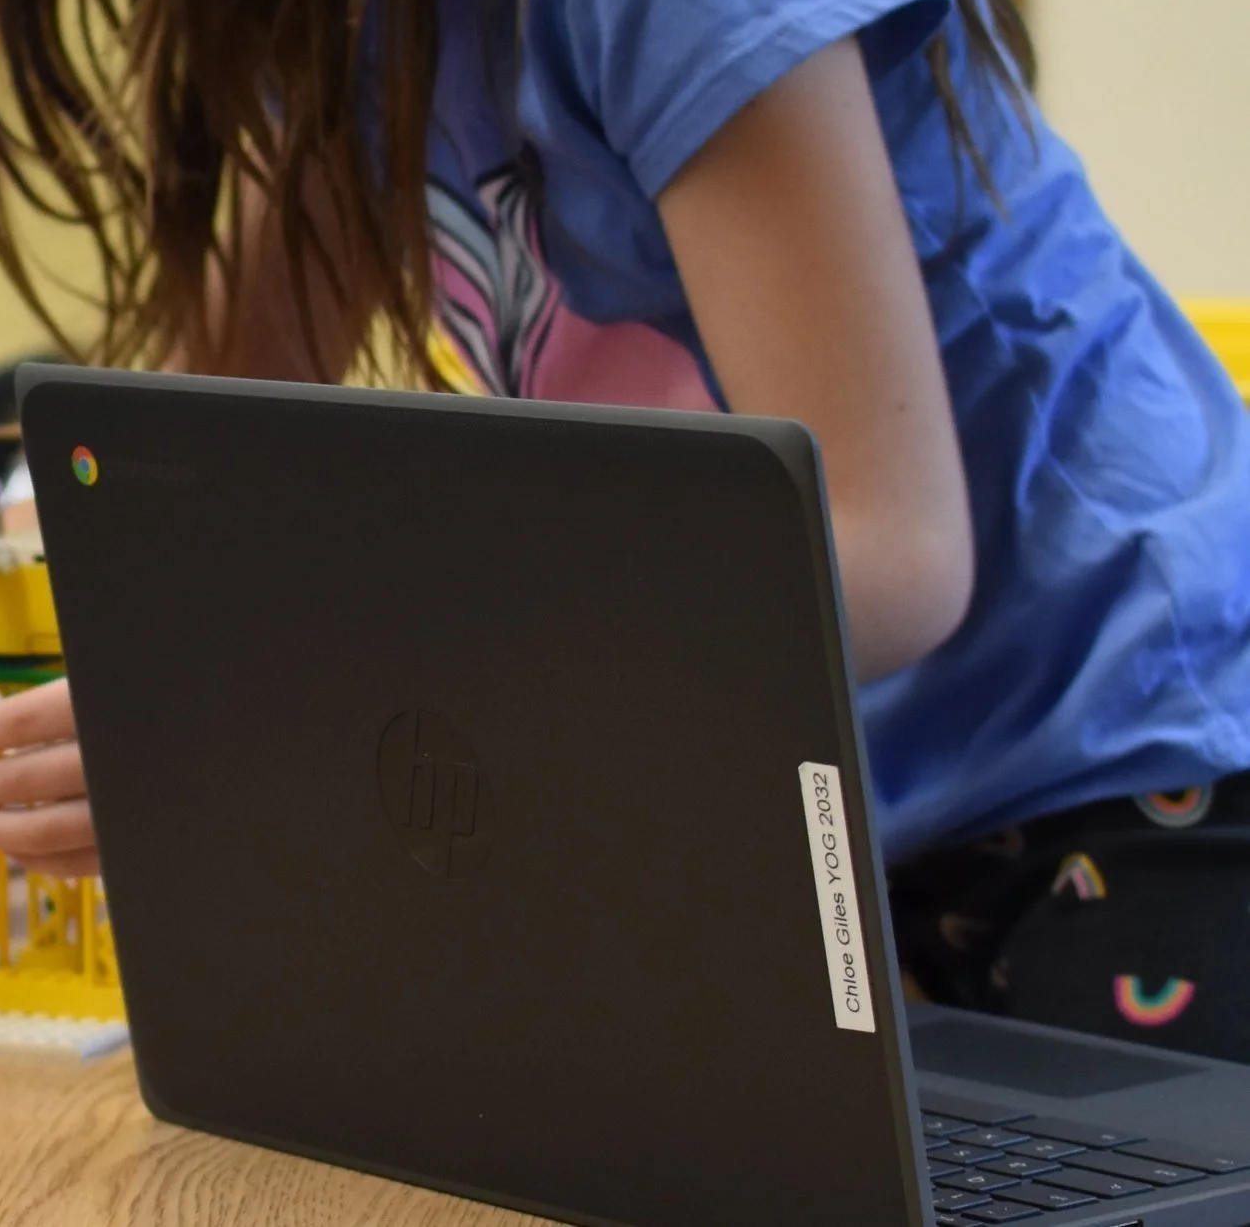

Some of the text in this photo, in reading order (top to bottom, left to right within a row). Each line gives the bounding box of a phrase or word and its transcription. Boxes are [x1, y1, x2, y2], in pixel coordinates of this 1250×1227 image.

[395, 708, 481, 881] hp
[812, 772, 860, 1013] Chloe Giles YOG 2032
